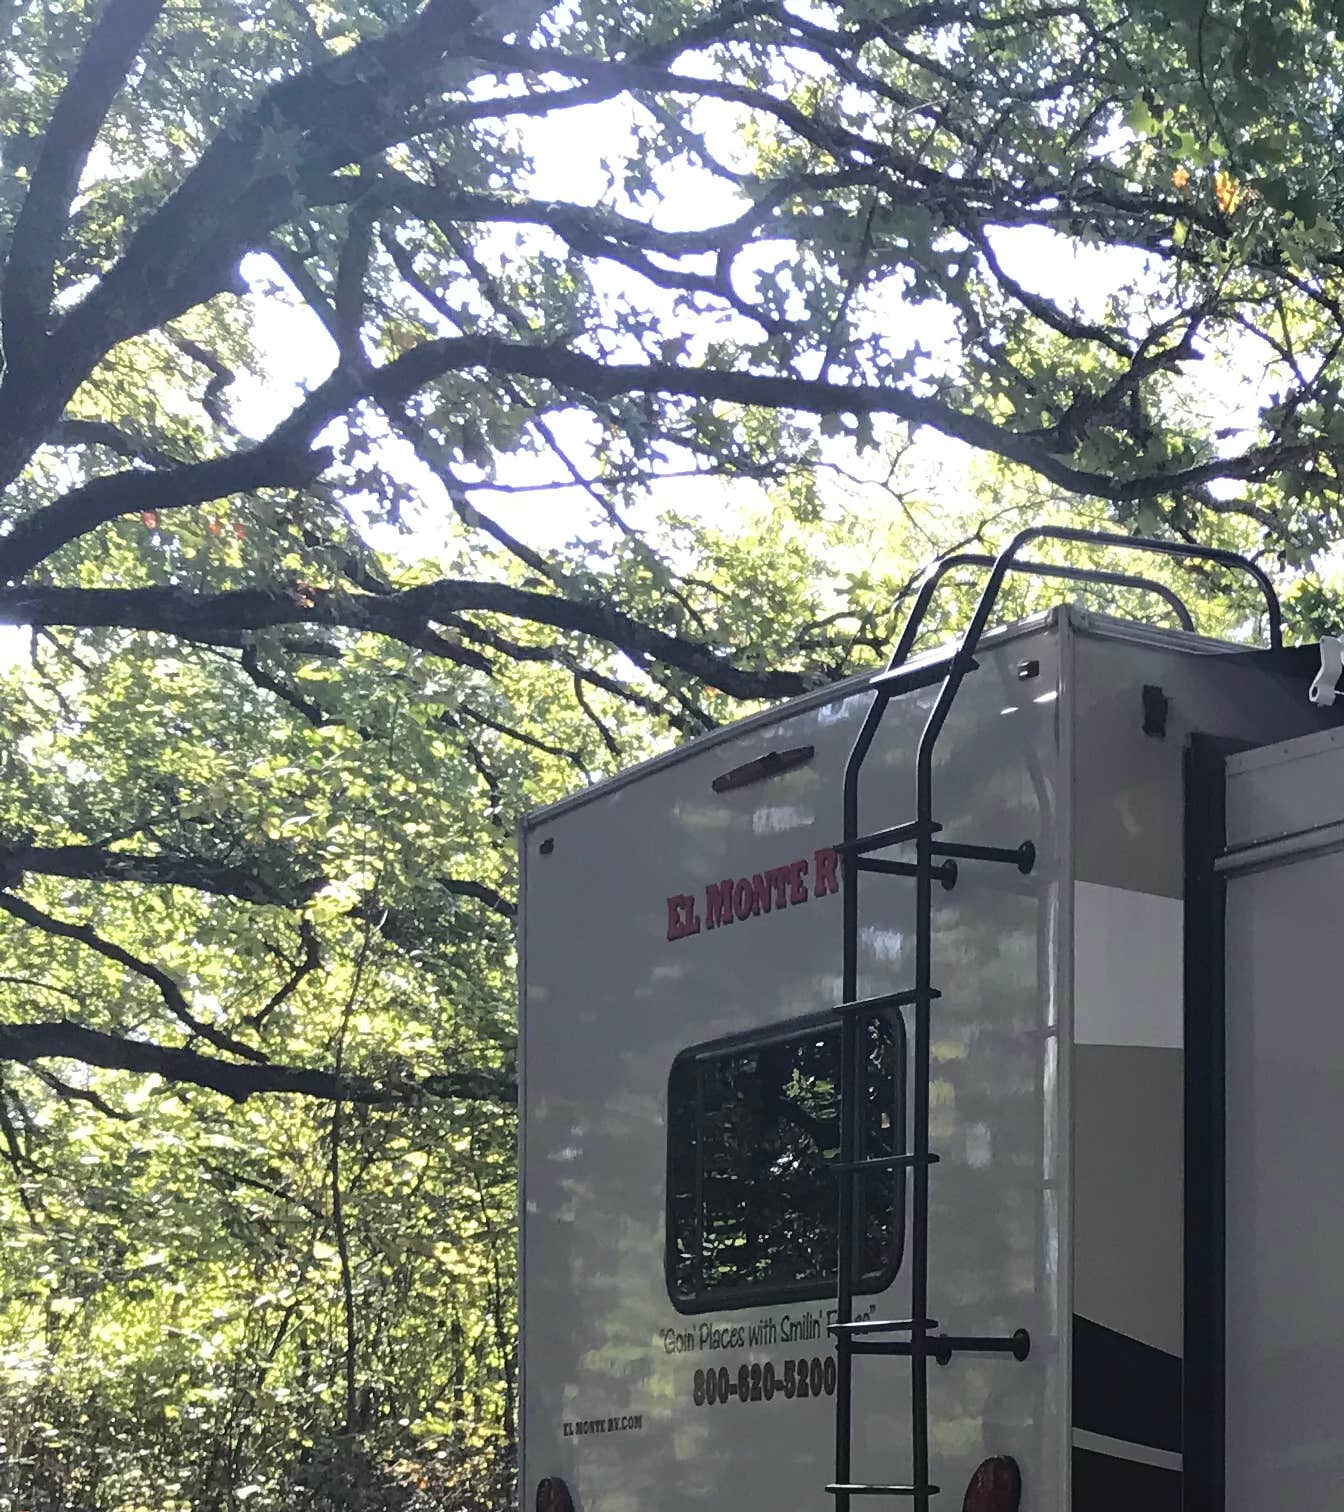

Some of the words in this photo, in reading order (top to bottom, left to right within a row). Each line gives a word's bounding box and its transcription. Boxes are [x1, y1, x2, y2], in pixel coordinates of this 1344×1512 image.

[667, 894, 700, 942] EL
[706, 860, 808, 930] MONTE
[814, 848, 844, 898] R
[699, 1322, 745, 1351] Places
[749, 1319, 777, 1346] with
[780, 1309, 823, 1343] Smilin'
[693, 1356, 837, 1406] 800-620-5200
